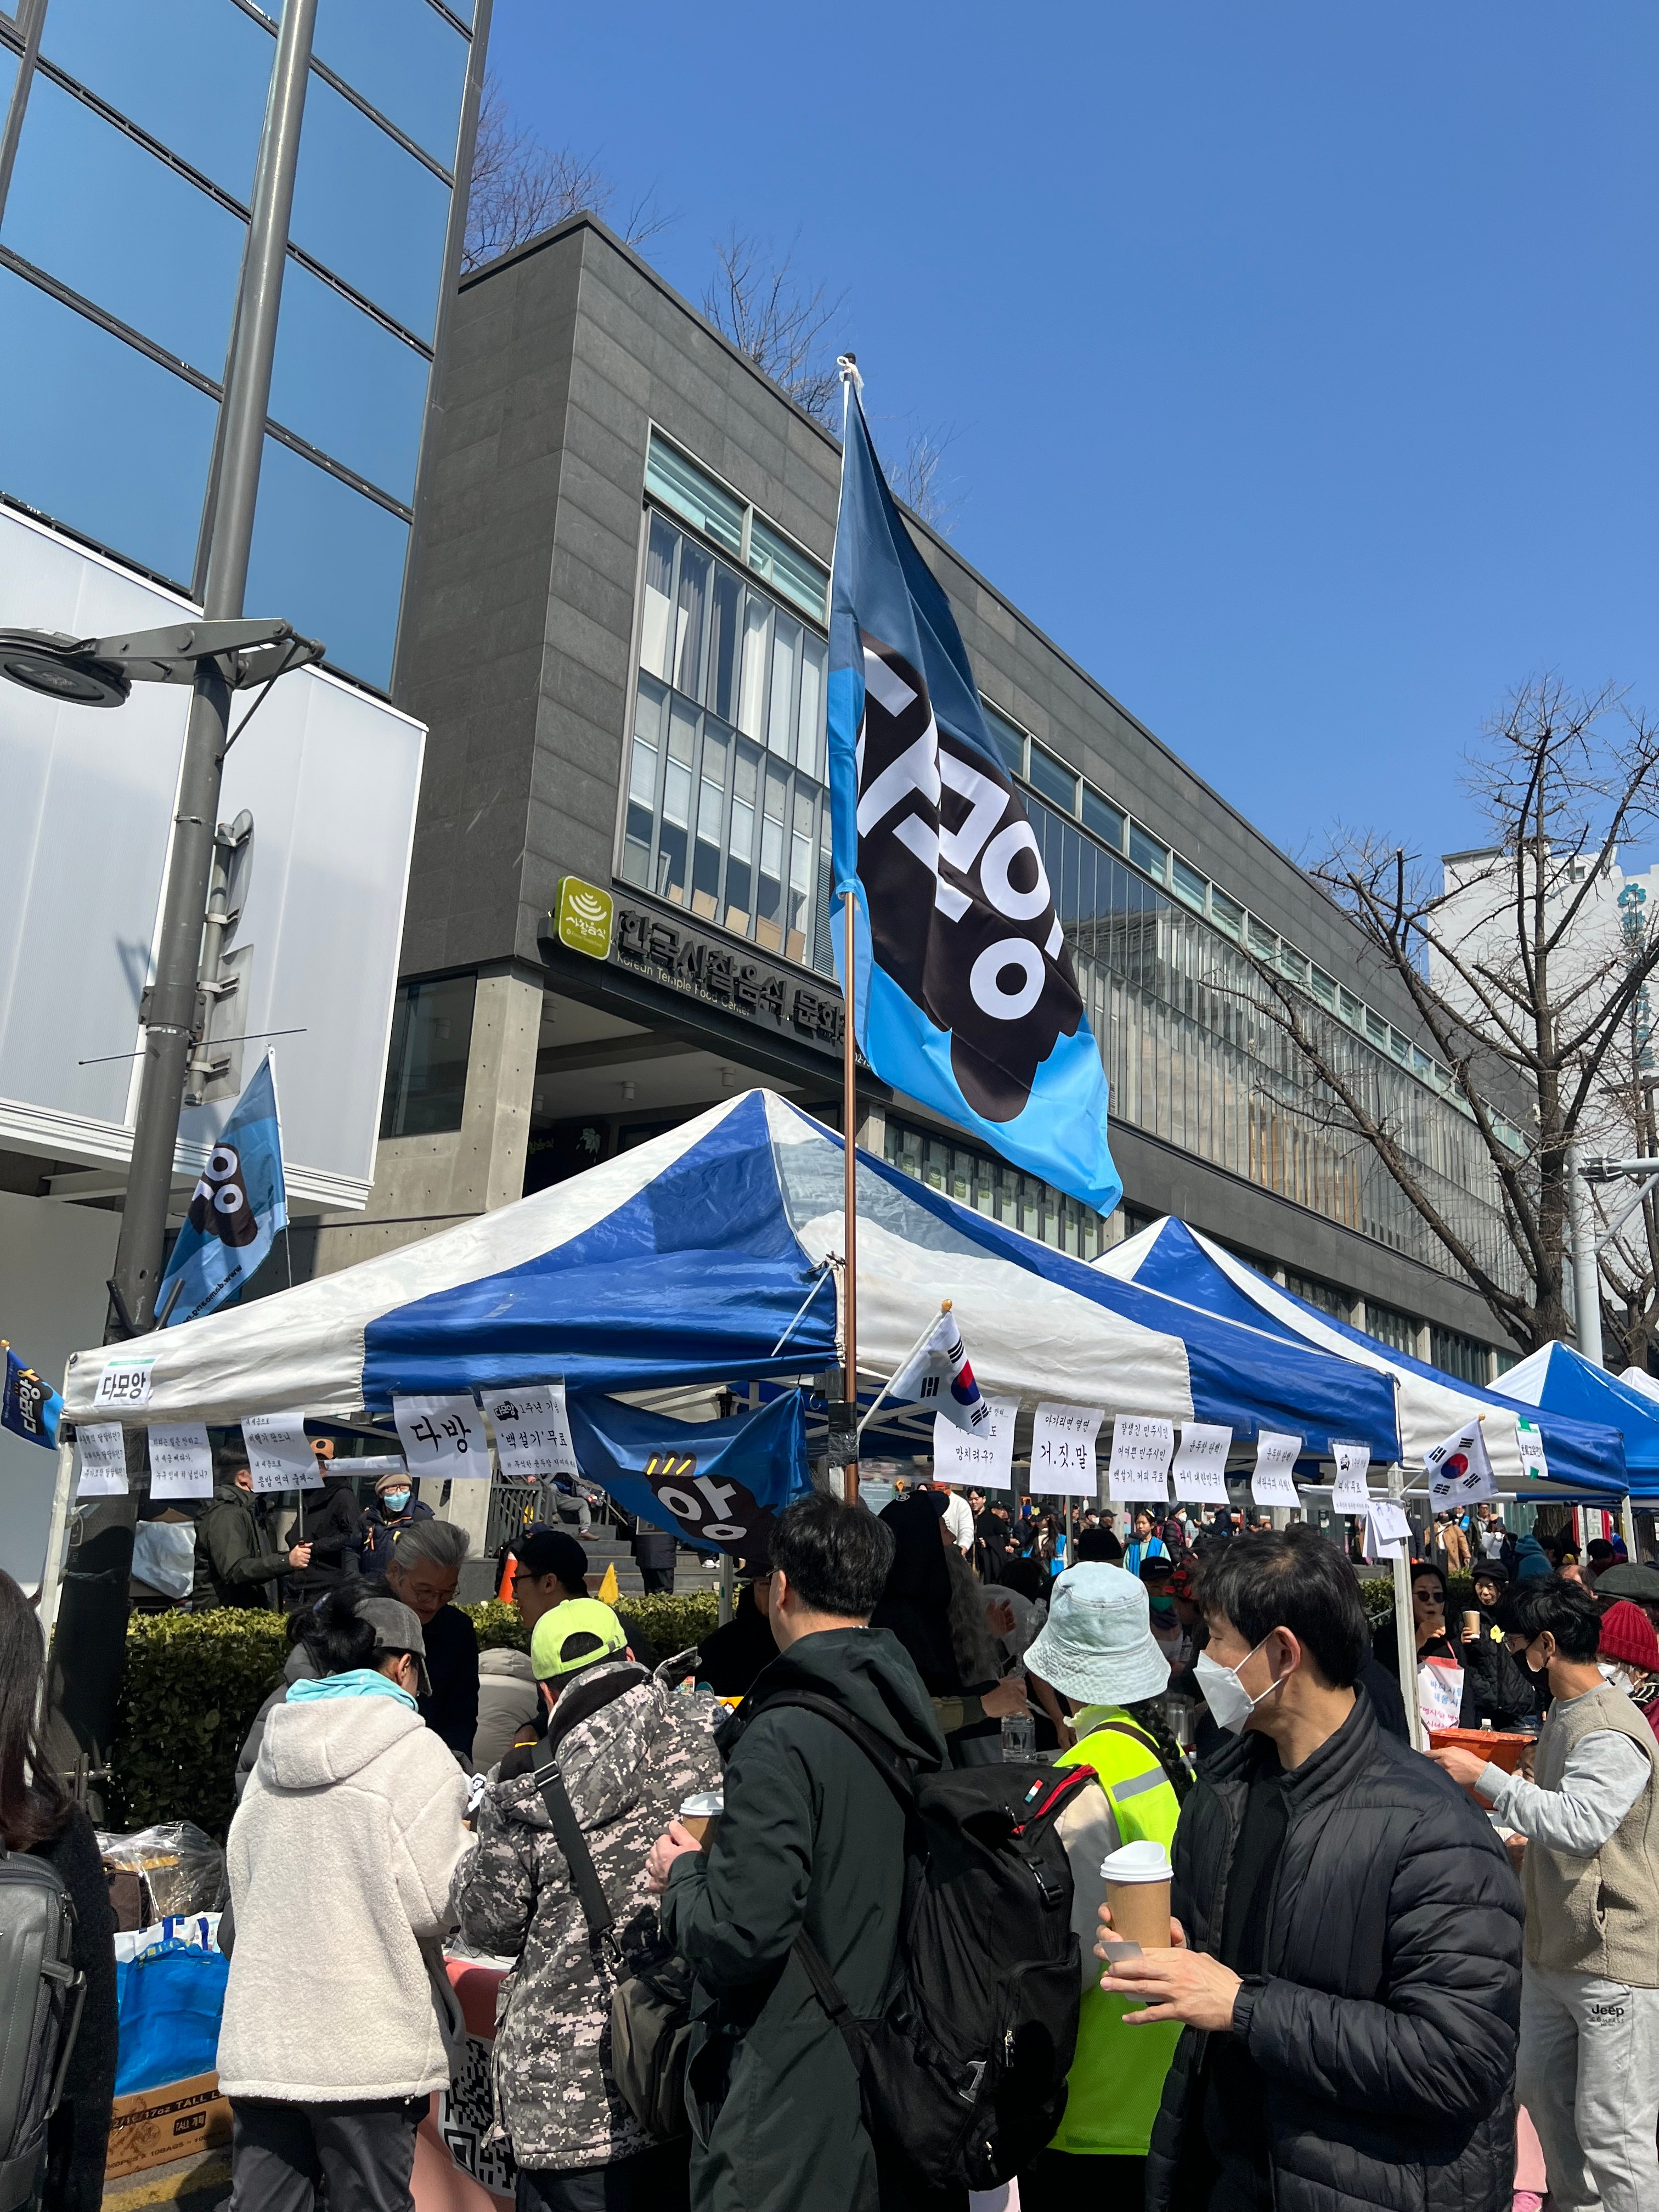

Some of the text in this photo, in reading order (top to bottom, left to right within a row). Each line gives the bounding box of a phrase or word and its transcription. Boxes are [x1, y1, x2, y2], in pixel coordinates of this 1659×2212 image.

[617, 952, 750, 1017] Korean Temple Food Center
[101, 1372, 146, 1401] 다모앙
[519, 1401, 543, 1414] 1주년
[410, 1414, 471, 1453] 다방
[1121, 1422, 1168, 1439] 잘생긴 민주시민
[547, 1430, 568, 1448] 무료
[1139, 1447, 1166, 1462] 민주시민
[1152, 1471, 1164, 1483] 무료
[1592, 2004, 1624, 2018] Jeep
[176, 2095, 207, 2109] TALL
